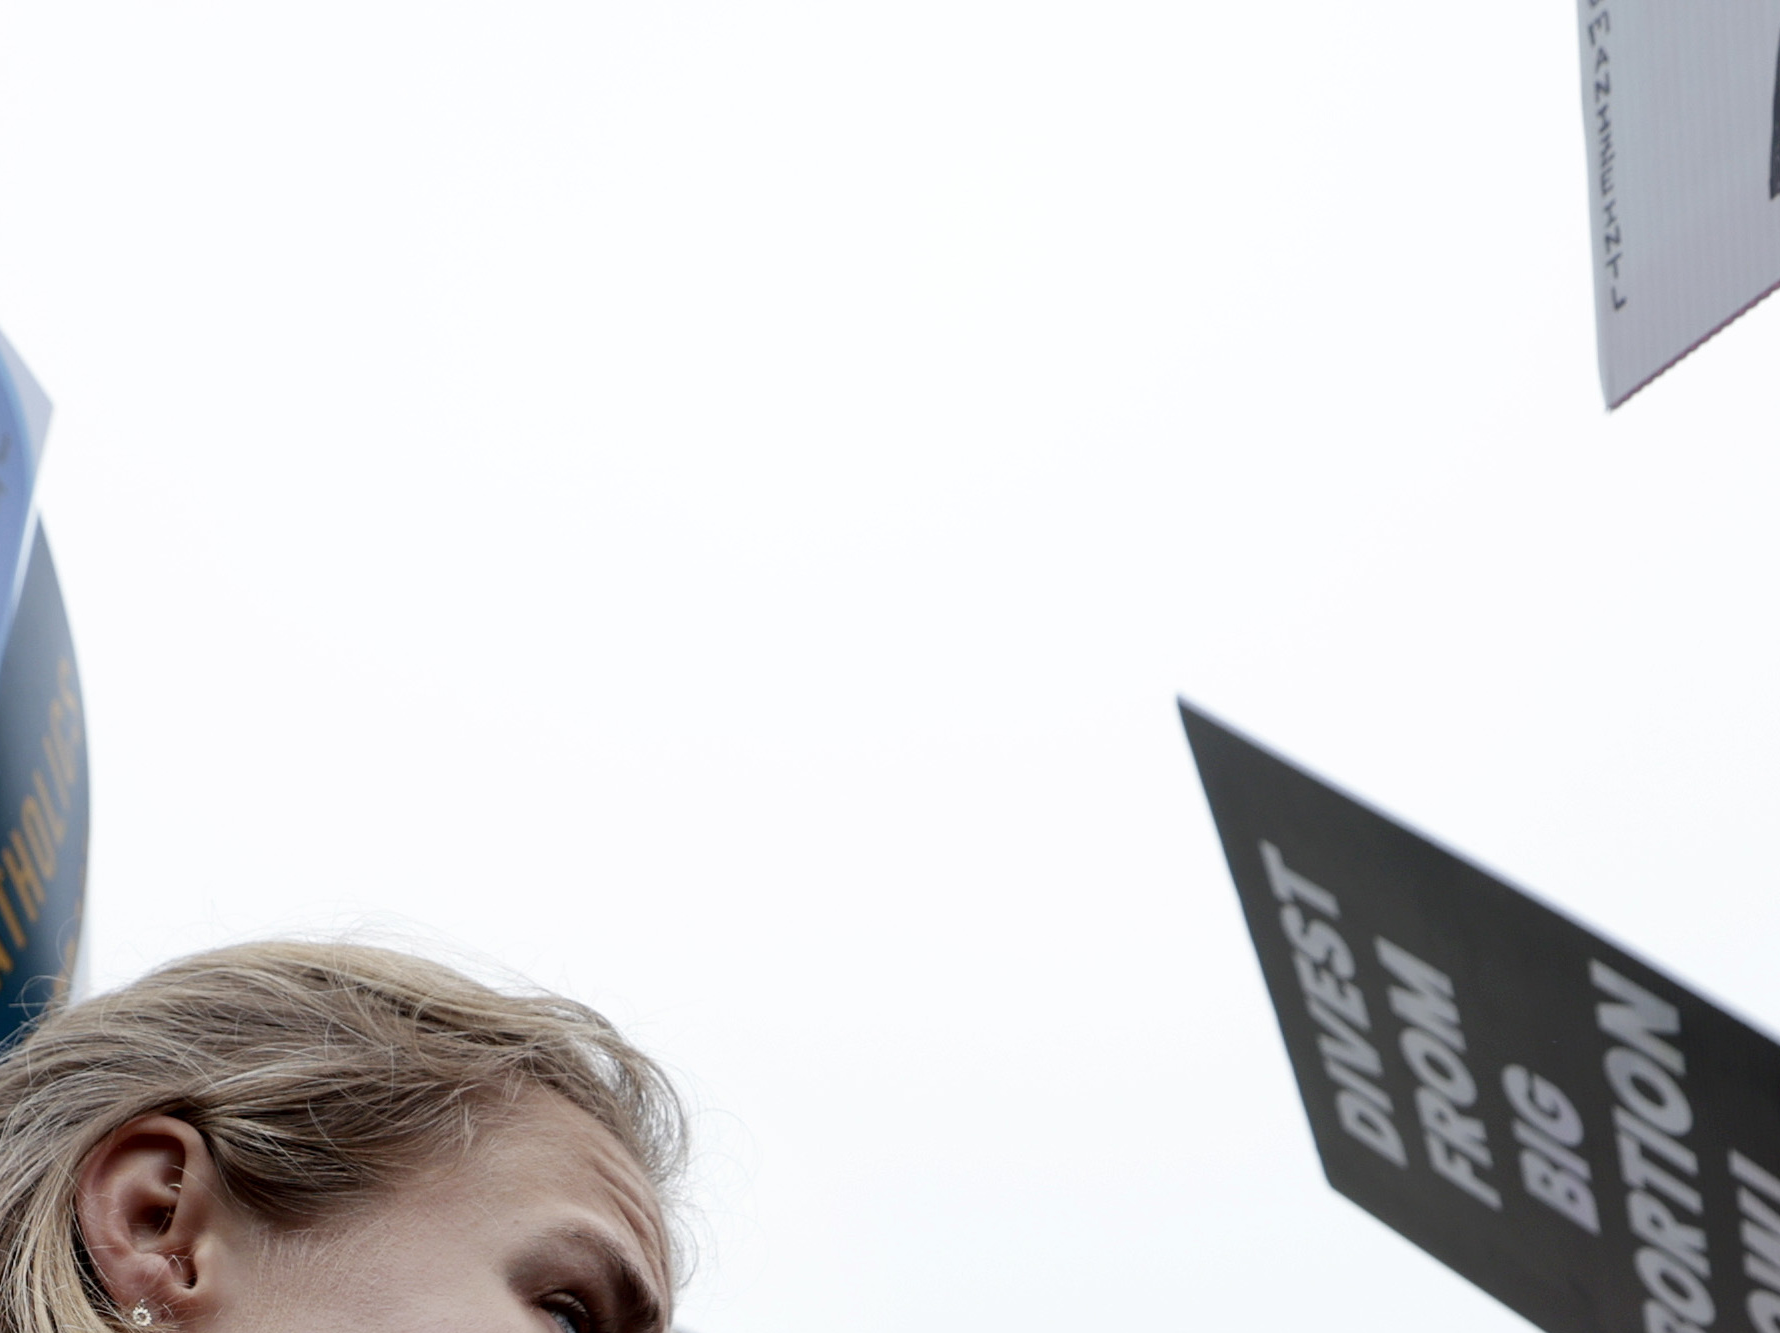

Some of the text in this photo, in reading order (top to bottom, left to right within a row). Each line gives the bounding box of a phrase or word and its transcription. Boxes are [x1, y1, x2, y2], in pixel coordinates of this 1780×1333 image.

[1260, 839, 1407, 1167] DIVEST
[1375, 936, 1501, 1210] FROM
[1503, 1064, 1600, 1237] BIG
